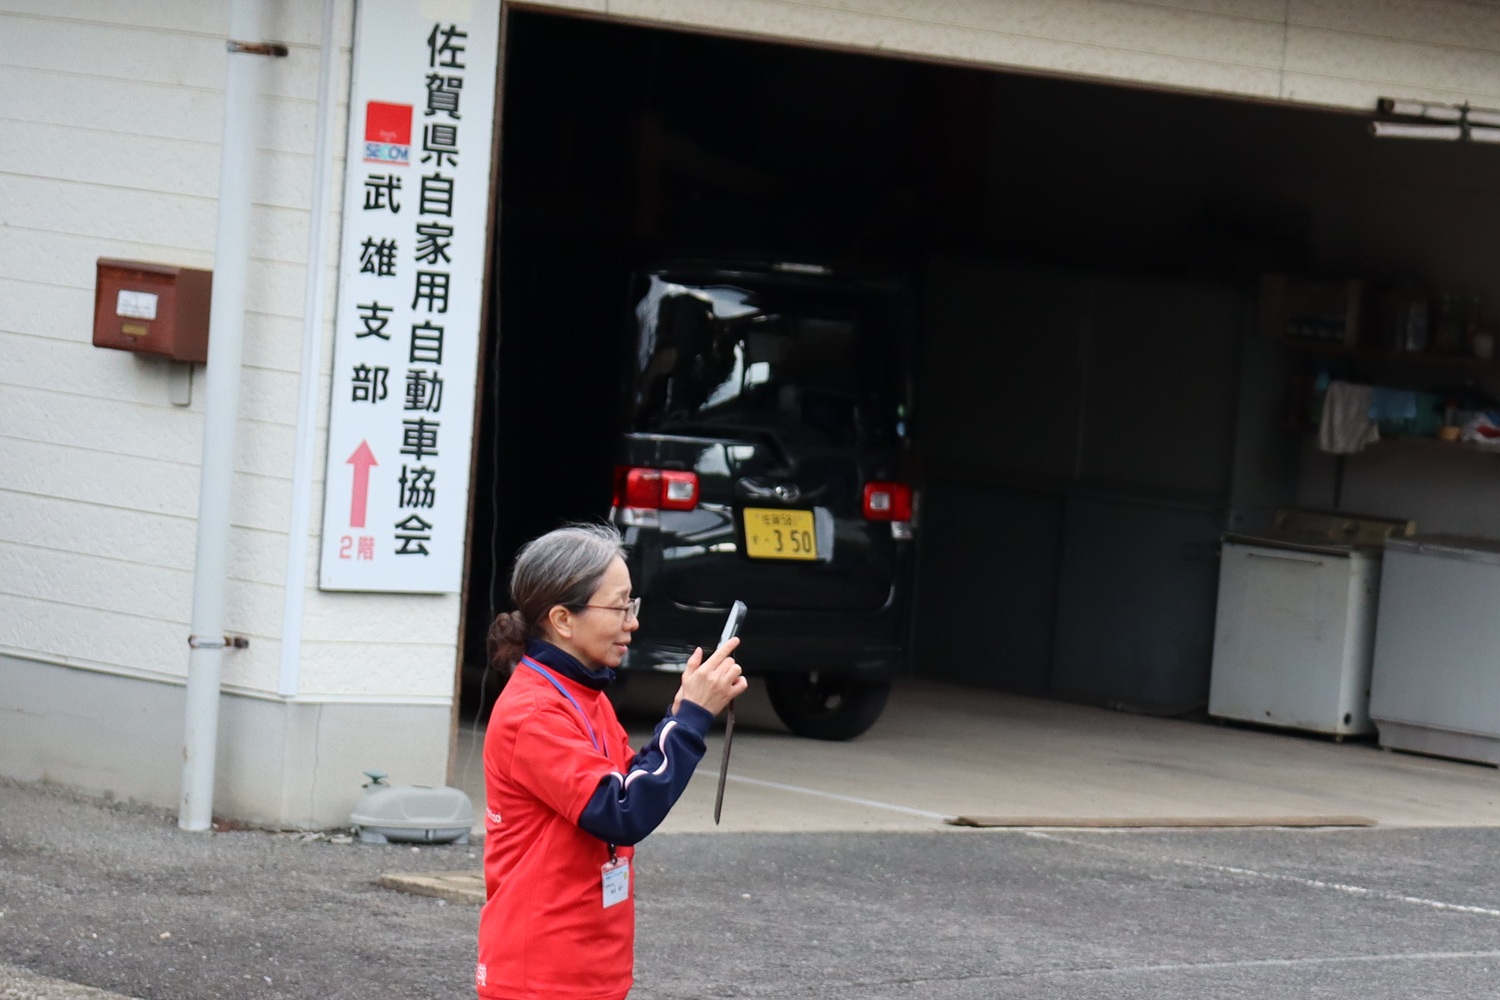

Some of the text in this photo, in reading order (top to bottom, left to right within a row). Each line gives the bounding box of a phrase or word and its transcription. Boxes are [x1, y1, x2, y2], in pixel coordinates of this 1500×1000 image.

[352, 174, 402, 404] 武雄支部
[394, 23, 468, 556] 佐賀県自家用自動車協会
[339, 535, 375, 560] 2階
